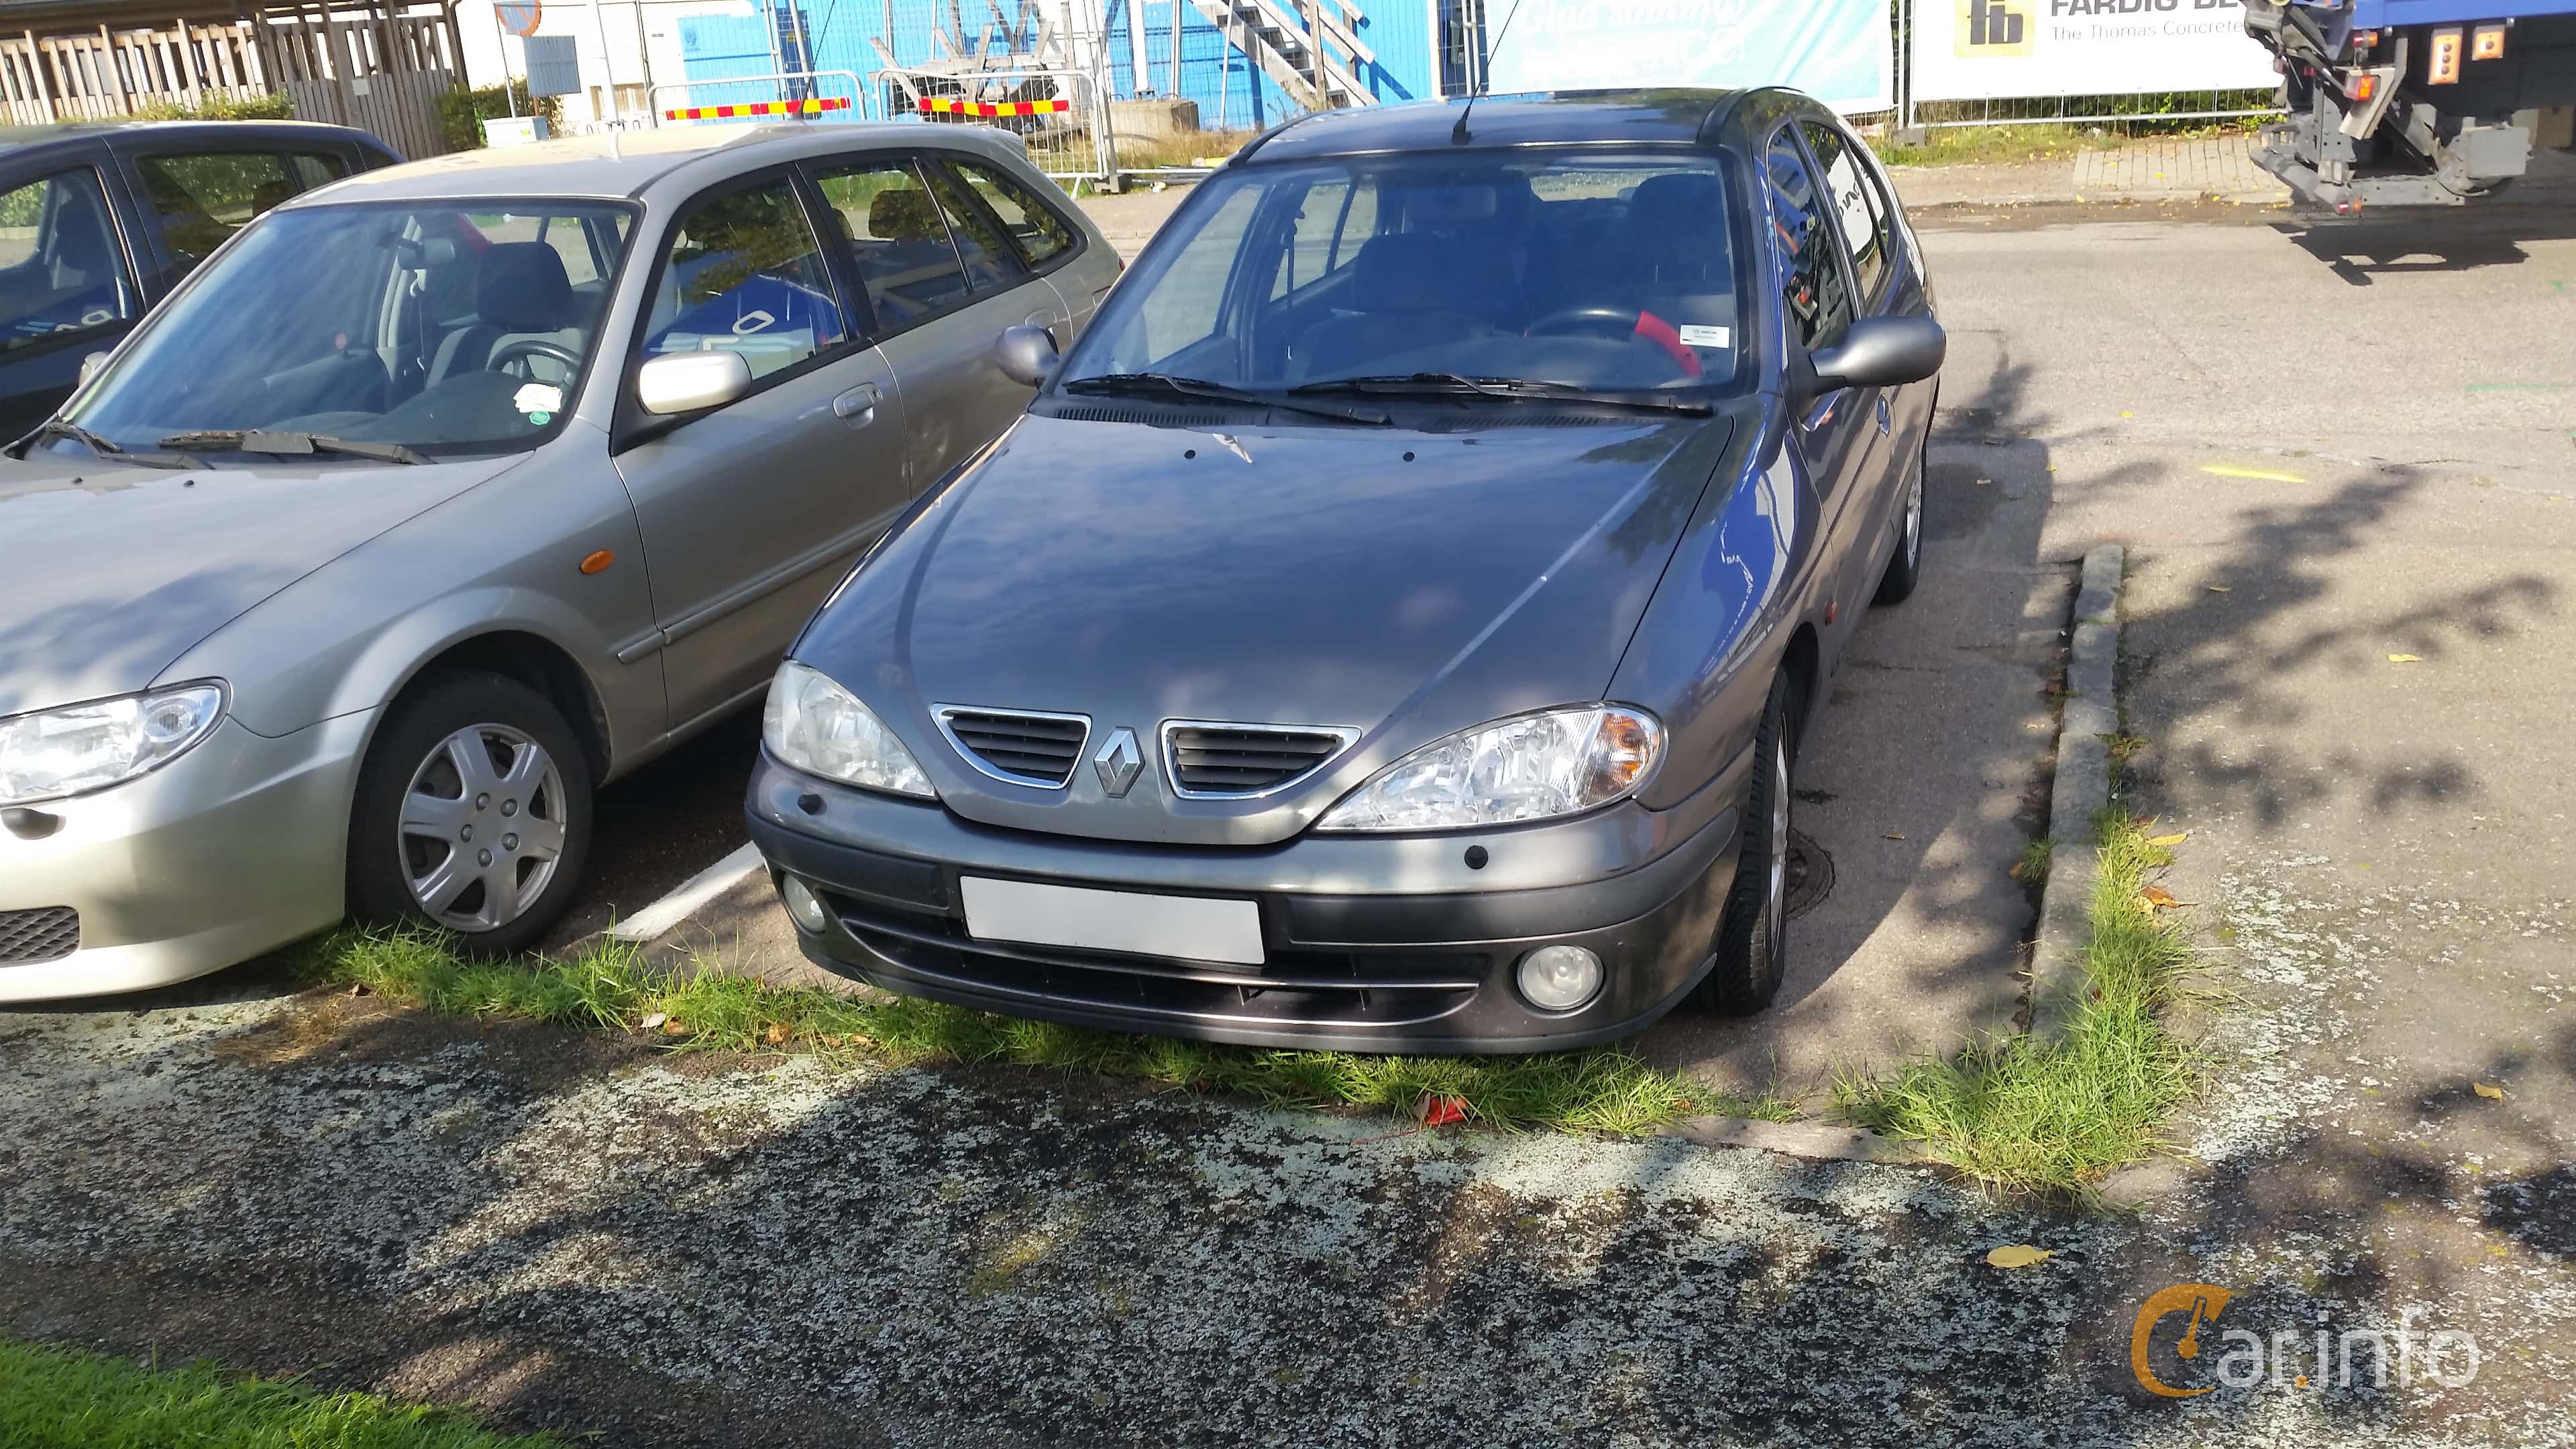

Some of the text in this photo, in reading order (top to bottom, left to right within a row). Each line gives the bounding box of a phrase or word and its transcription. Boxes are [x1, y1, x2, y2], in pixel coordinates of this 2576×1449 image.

[2051, 19, 2243, 41] The Thomas Concrete
